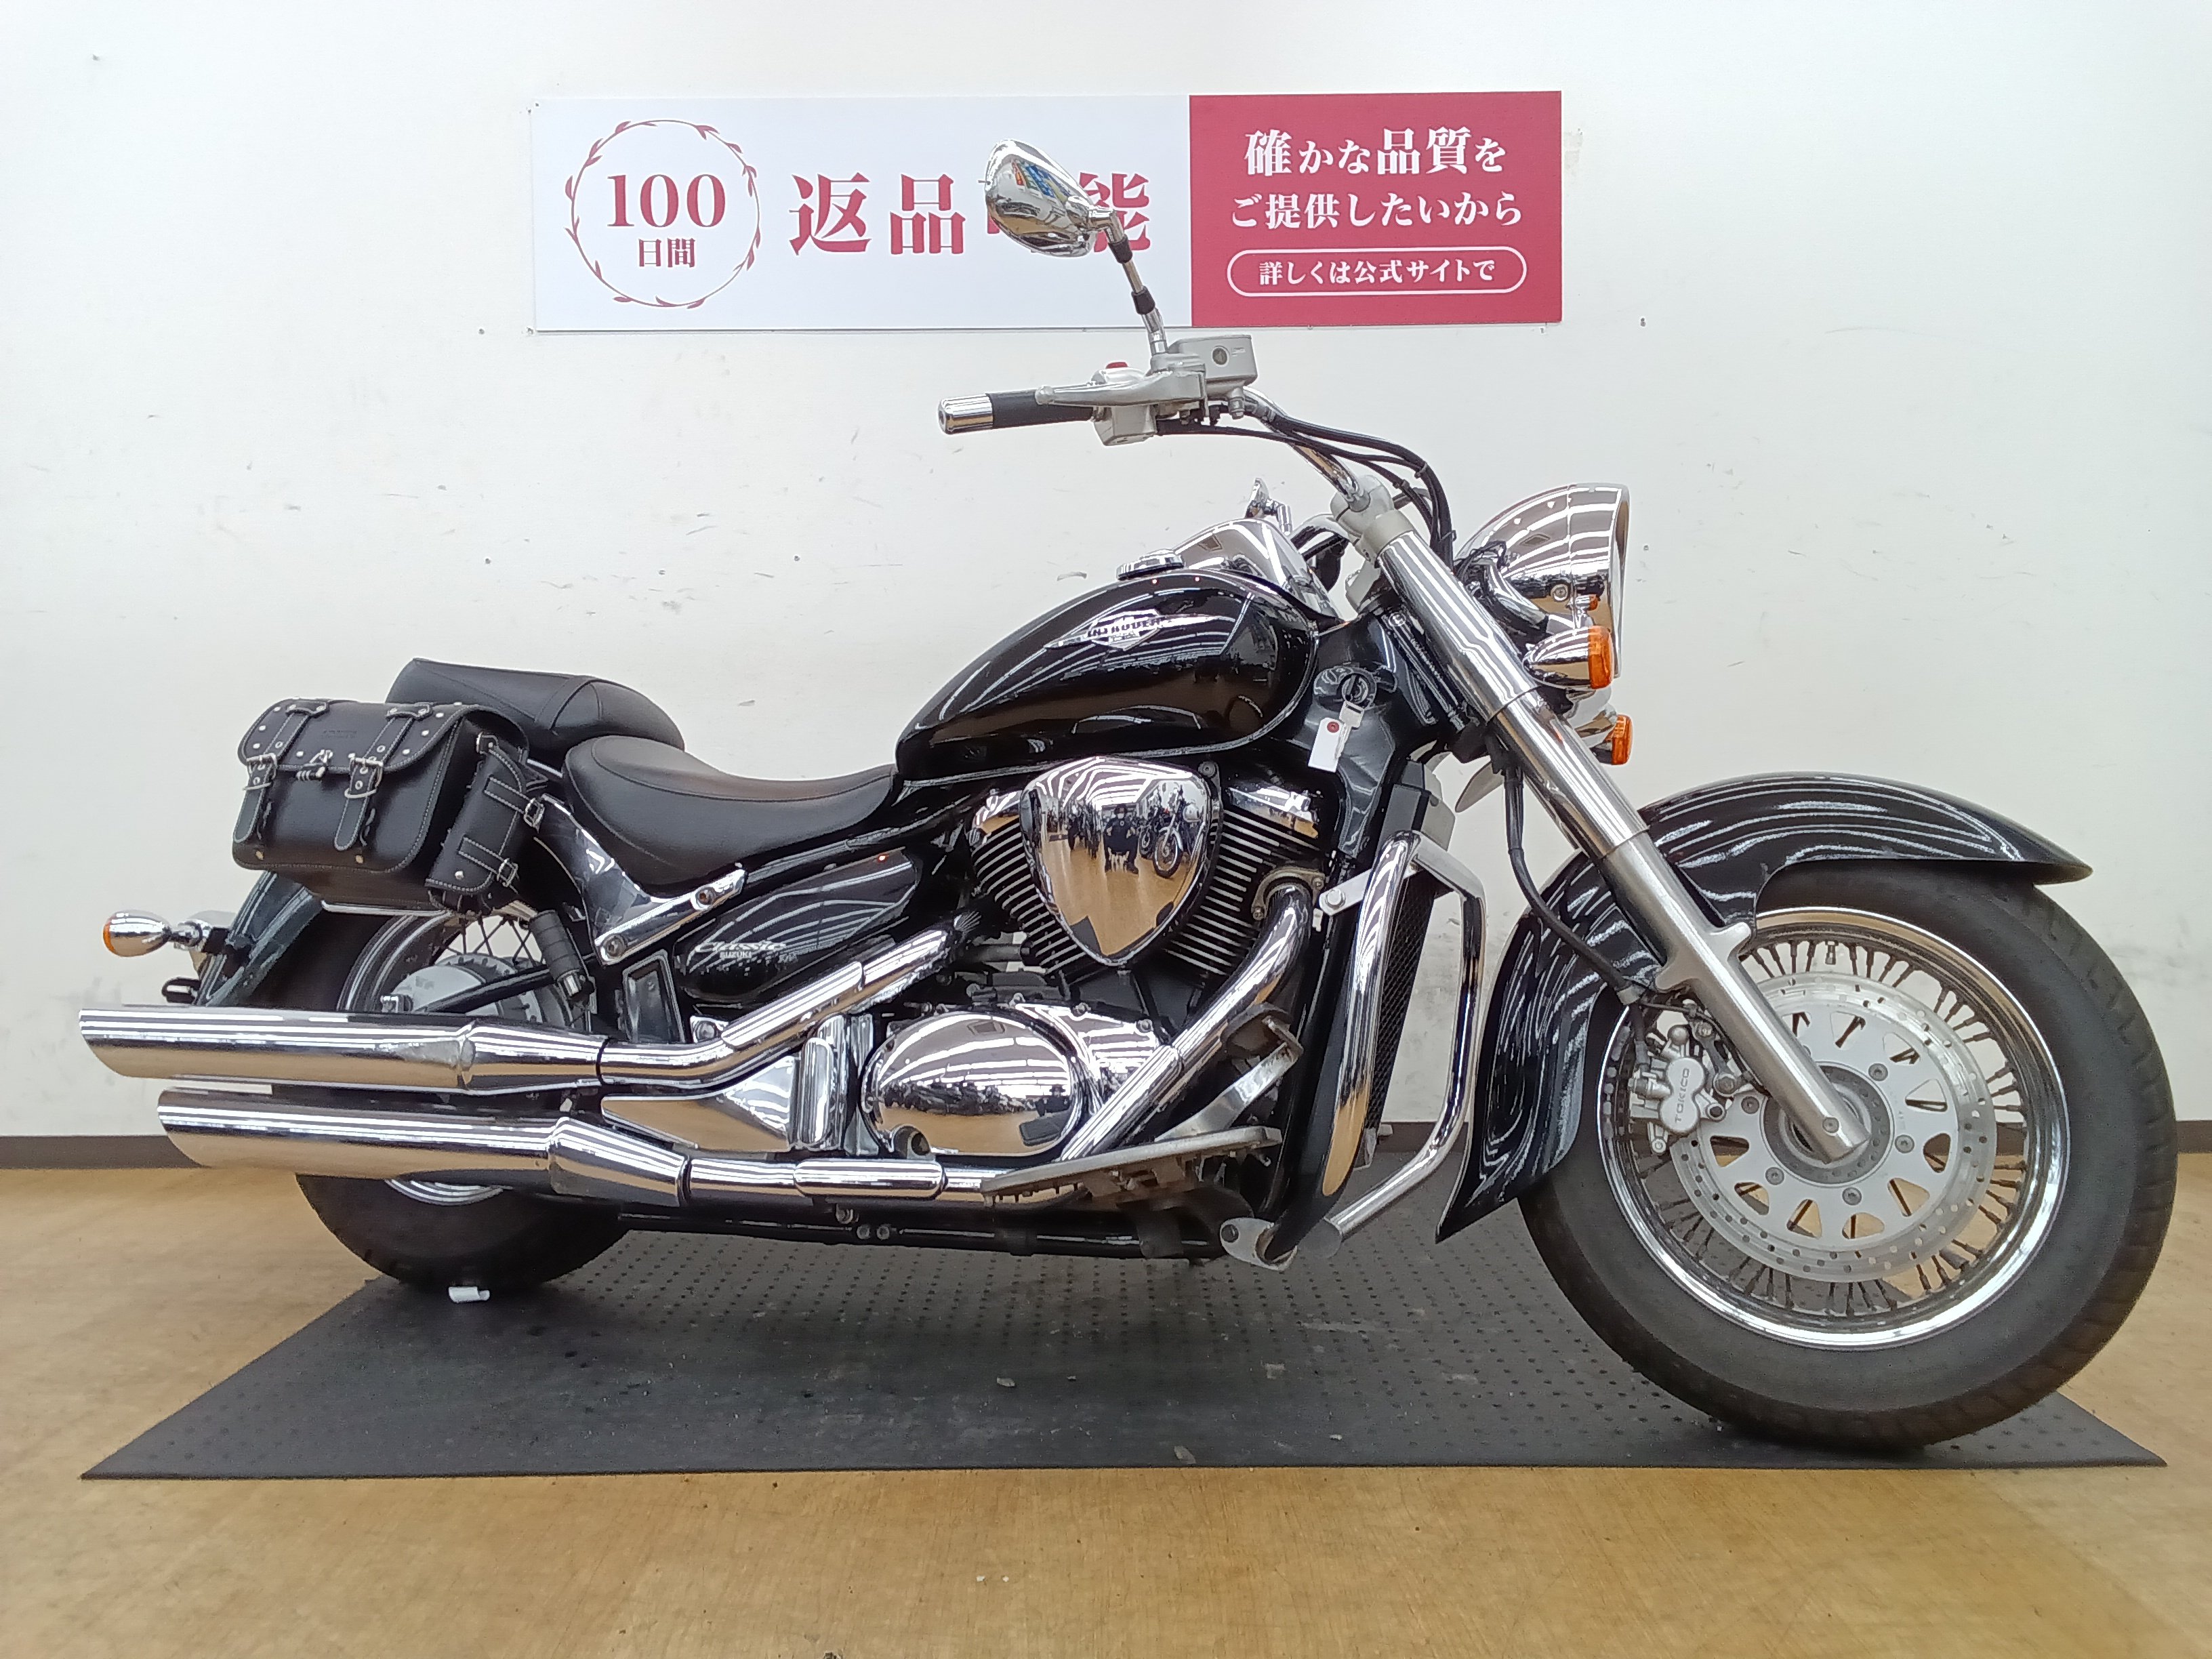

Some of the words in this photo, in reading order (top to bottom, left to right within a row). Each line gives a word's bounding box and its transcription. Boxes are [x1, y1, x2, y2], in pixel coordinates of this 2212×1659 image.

[1244, 126, 1506, 177] 確かな品質を
[607, 174, 726, 227] 100
[788, 171, 1151, 255] 返品能
[1232, 191, 1522, 230] ご提供したいから
[638, 238, 696, 268] 日間
[1258, 259, 1496, 285] 詳しくは公式サイトで
[719, 951, 752, 959] SUZUKI
[1674, 1067, 1690, 1124] TOKICO
